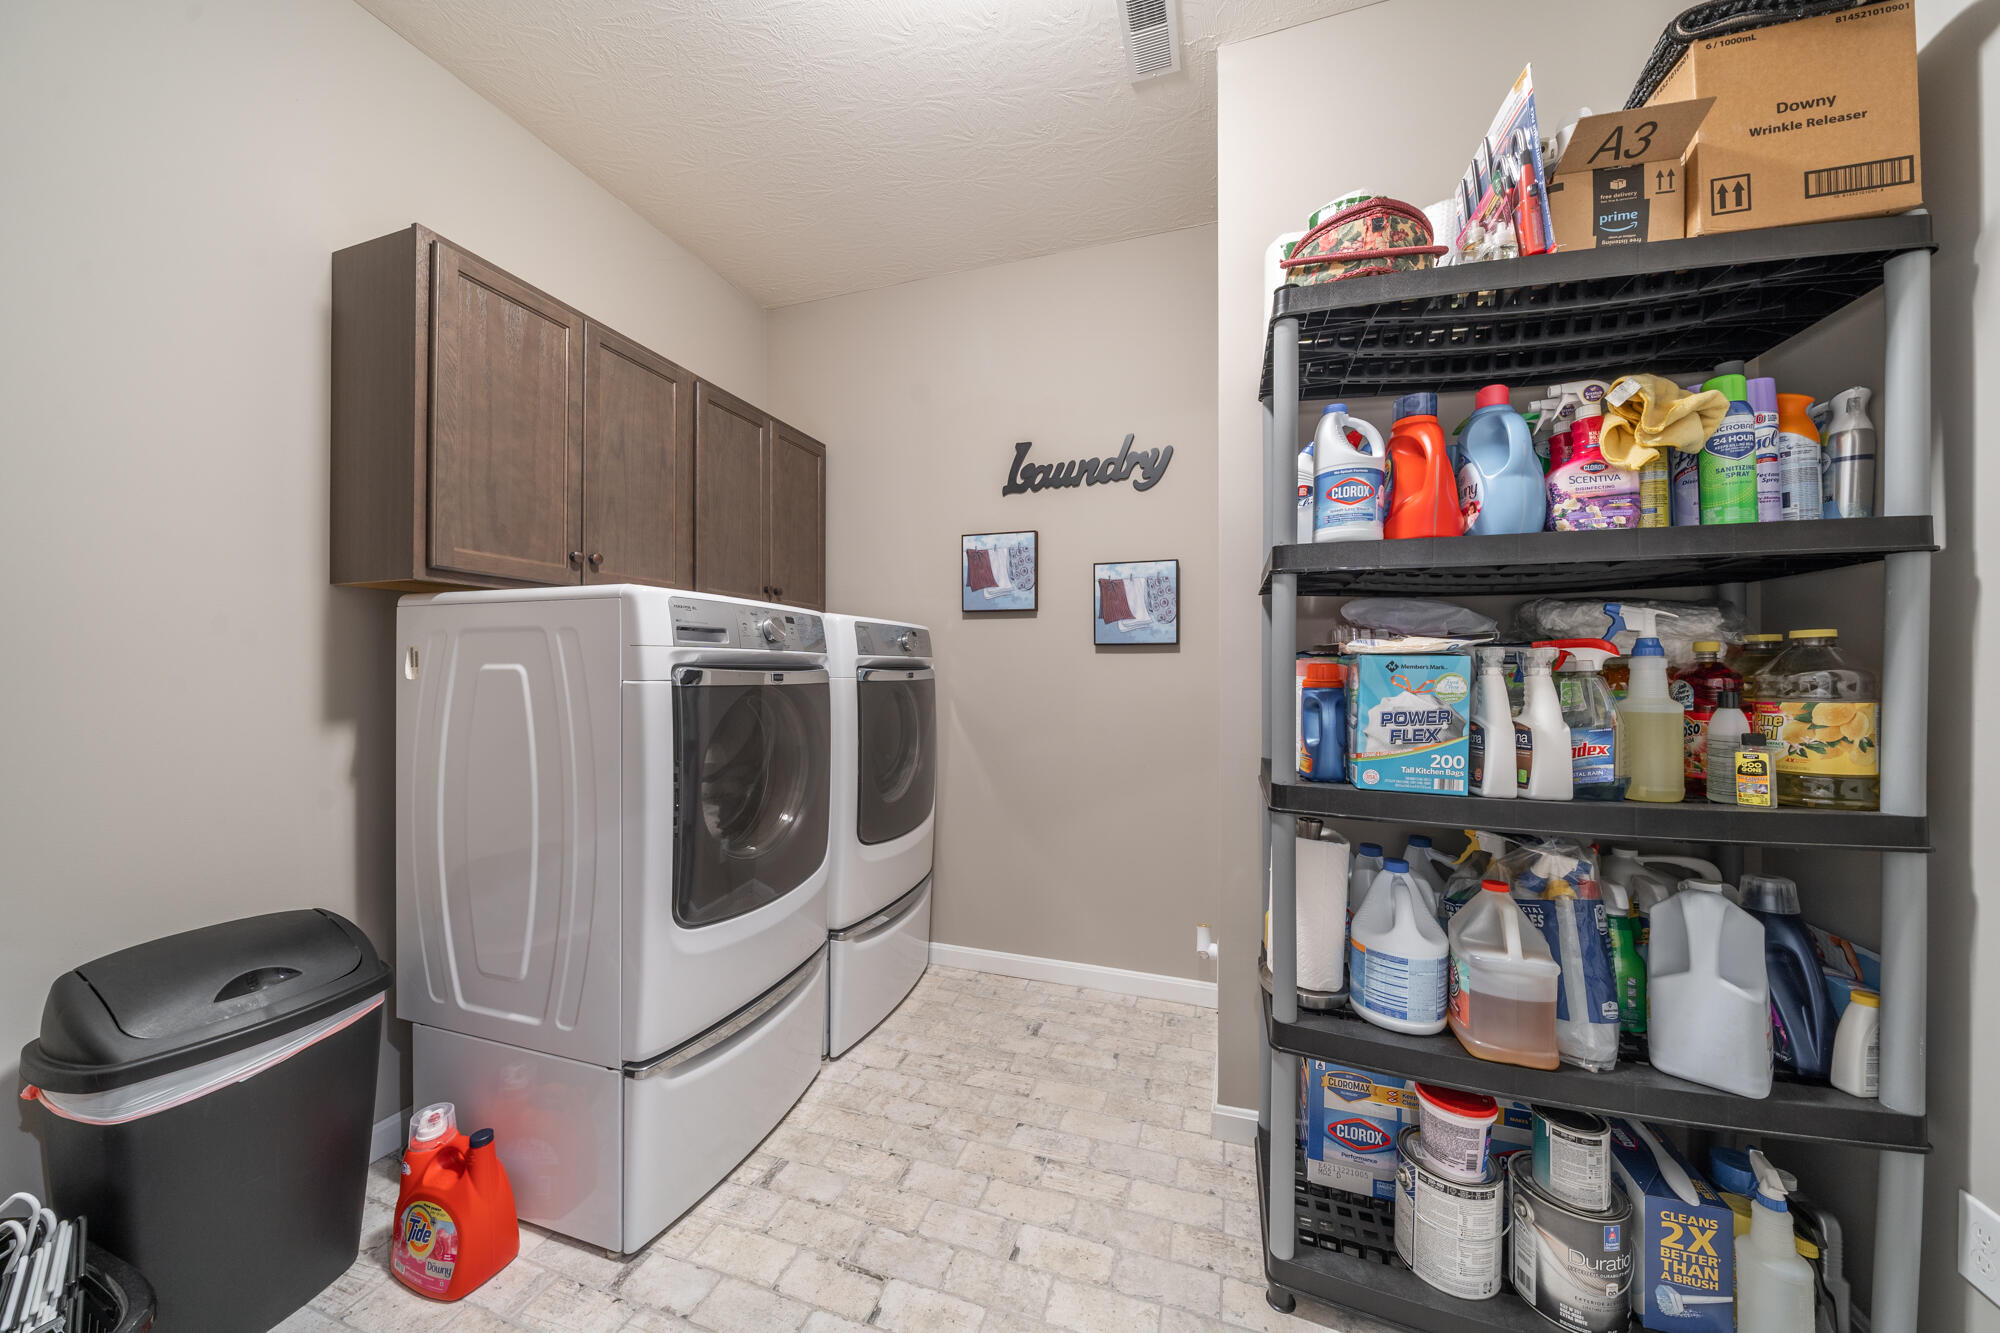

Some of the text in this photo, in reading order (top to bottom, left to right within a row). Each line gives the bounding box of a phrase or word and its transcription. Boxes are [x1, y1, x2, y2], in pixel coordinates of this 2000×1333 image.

[1720, 34, 1757, 48] 1000mL
[1776, 94, 1836, 114] Downy
[1749, 109, 1868, 137] Wrinkle Releaser
[1587, 121, 1658, 164] A3
[1600, 211, 1638, 225] prime
[1713, 434, 1754, 446] 24 HOUR
[1002, 433, 1174, 497] Laundry
[1583, 463, 1605, 471] CLOROX
[1569, 474, 1621, 485] SCENTIVA
[1726, 471, 1750, 479] SPRAY
[1331, 485, 1370, 499] CLOROX
[1380, 710, 1452, 727] POWER
[1390, 728, 1441, 744] FLEX
[1572, 741, 1611, 760] ndex
[1430, 754, 1465, 769] 200
[1416, 767, 1445, 775] Kitchen
[1328, 1077, 1371, 1093] CLOROMAX
[1336, 1124, 1383, 1145] CLOROX
[1341, 1151, 1378, 1164] Performance
[1660, 1210, 1719, 1229] CLEANS
[407, 1218, 432, 1243] Tide
[1660, 1221, 1718, 1257] 2X
[1568, 1248, 1631, 1271] Duratio
[427, 1261, 452, 1278] Downy
[1660, 1257, 1719, 1281] THAN
[1661, 1271, 1719, 1291] A BRUSH
